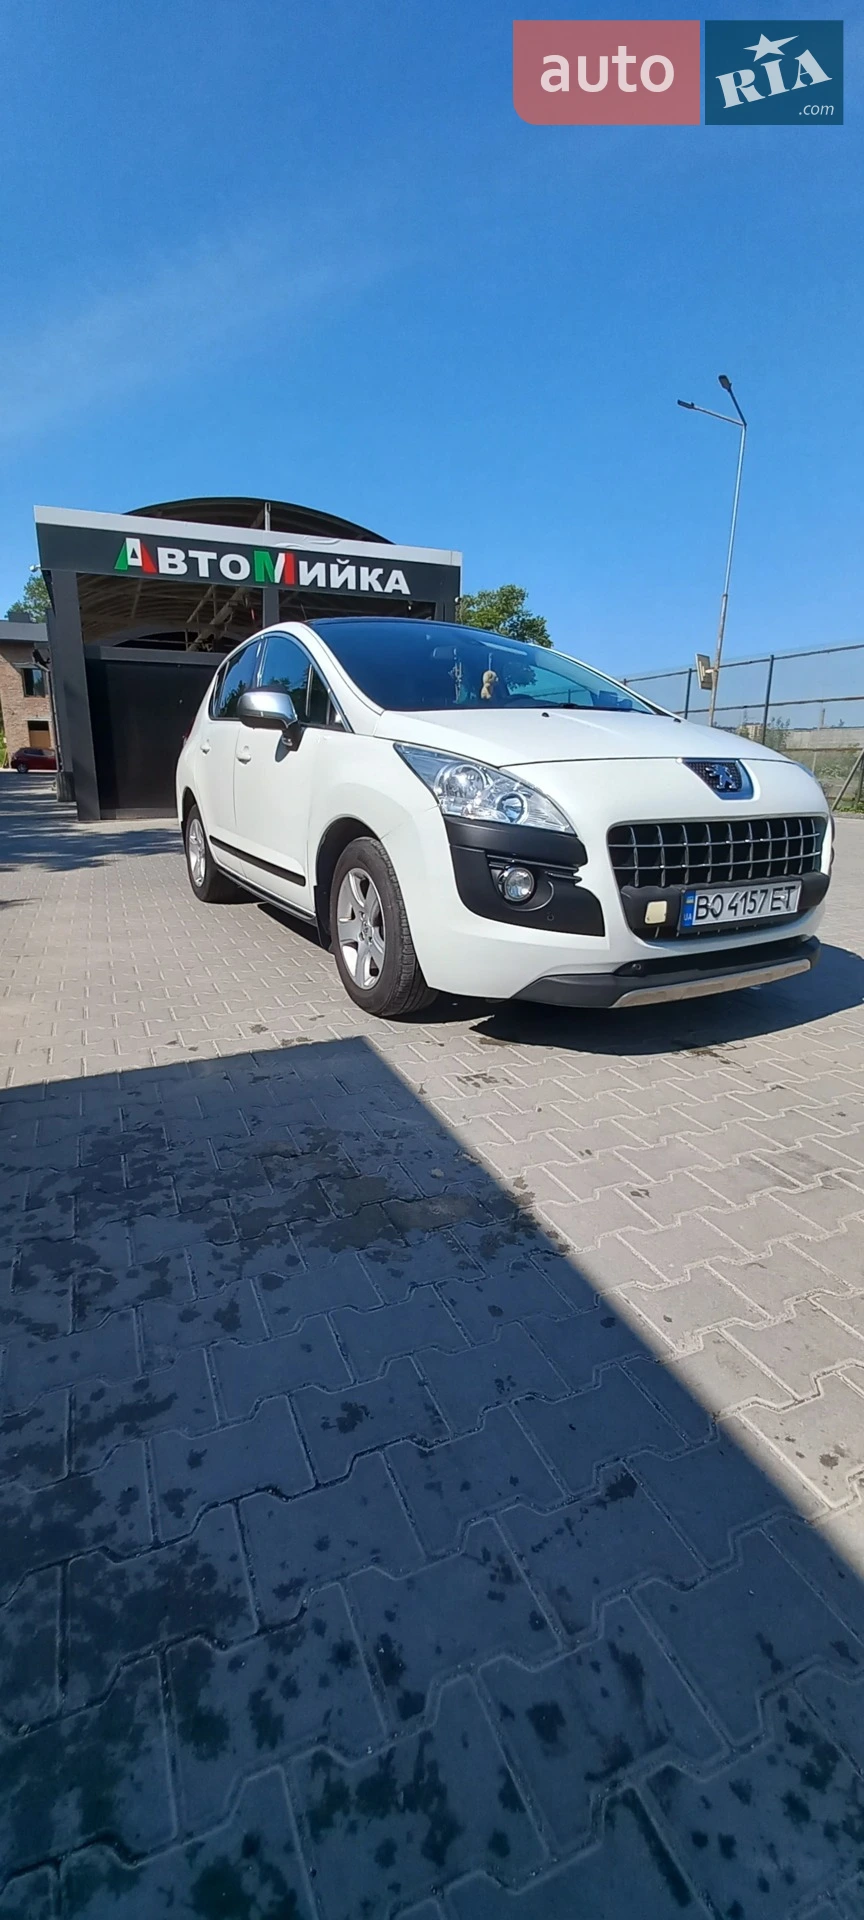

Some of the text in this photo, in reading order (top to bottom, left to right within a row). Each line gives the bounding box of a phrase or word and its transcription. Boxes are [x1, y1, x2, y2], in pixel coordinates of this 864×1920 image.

[696, 886, 796, 921] BO 4157 ET
[683, 912, 692, 921] UA
